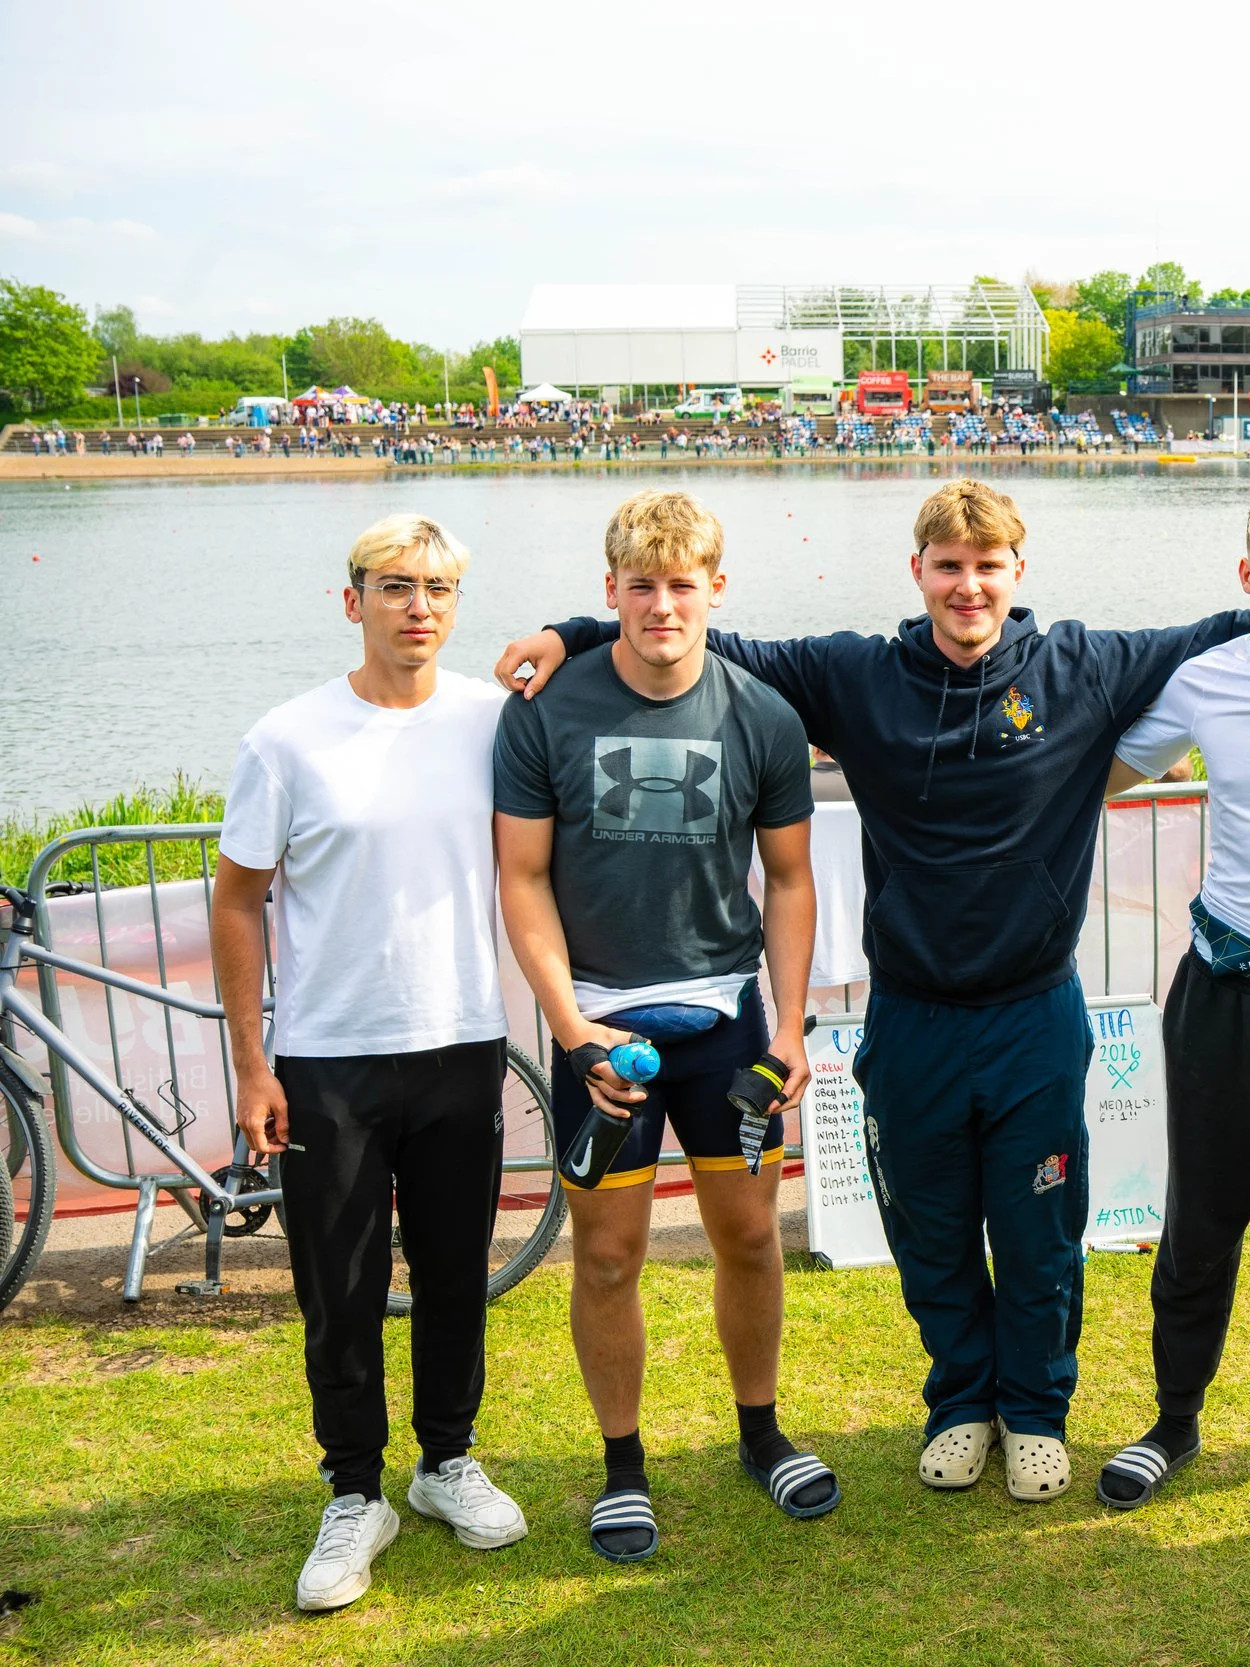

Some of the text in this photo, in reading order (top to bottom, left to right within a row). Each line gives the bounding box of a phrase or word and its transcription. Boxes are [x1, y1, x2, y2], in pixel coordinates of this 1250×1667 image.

[781, 345, 817, 356] Barrio
[782, 357, 820, 368] PADEL
[860, 376, 892, 385] COFFEE
[932, 373, 950, 382] THE
[592, 830, 717, 844] UNDER ARMOUR
[1099, 1042, 1141, 1062] 2026
[815, 1063, 843, 1072] CREW
[1099, 1099, 1156, 1112] MEDALS:
[117, 1102, 172, 1154] RIVERSIDE
